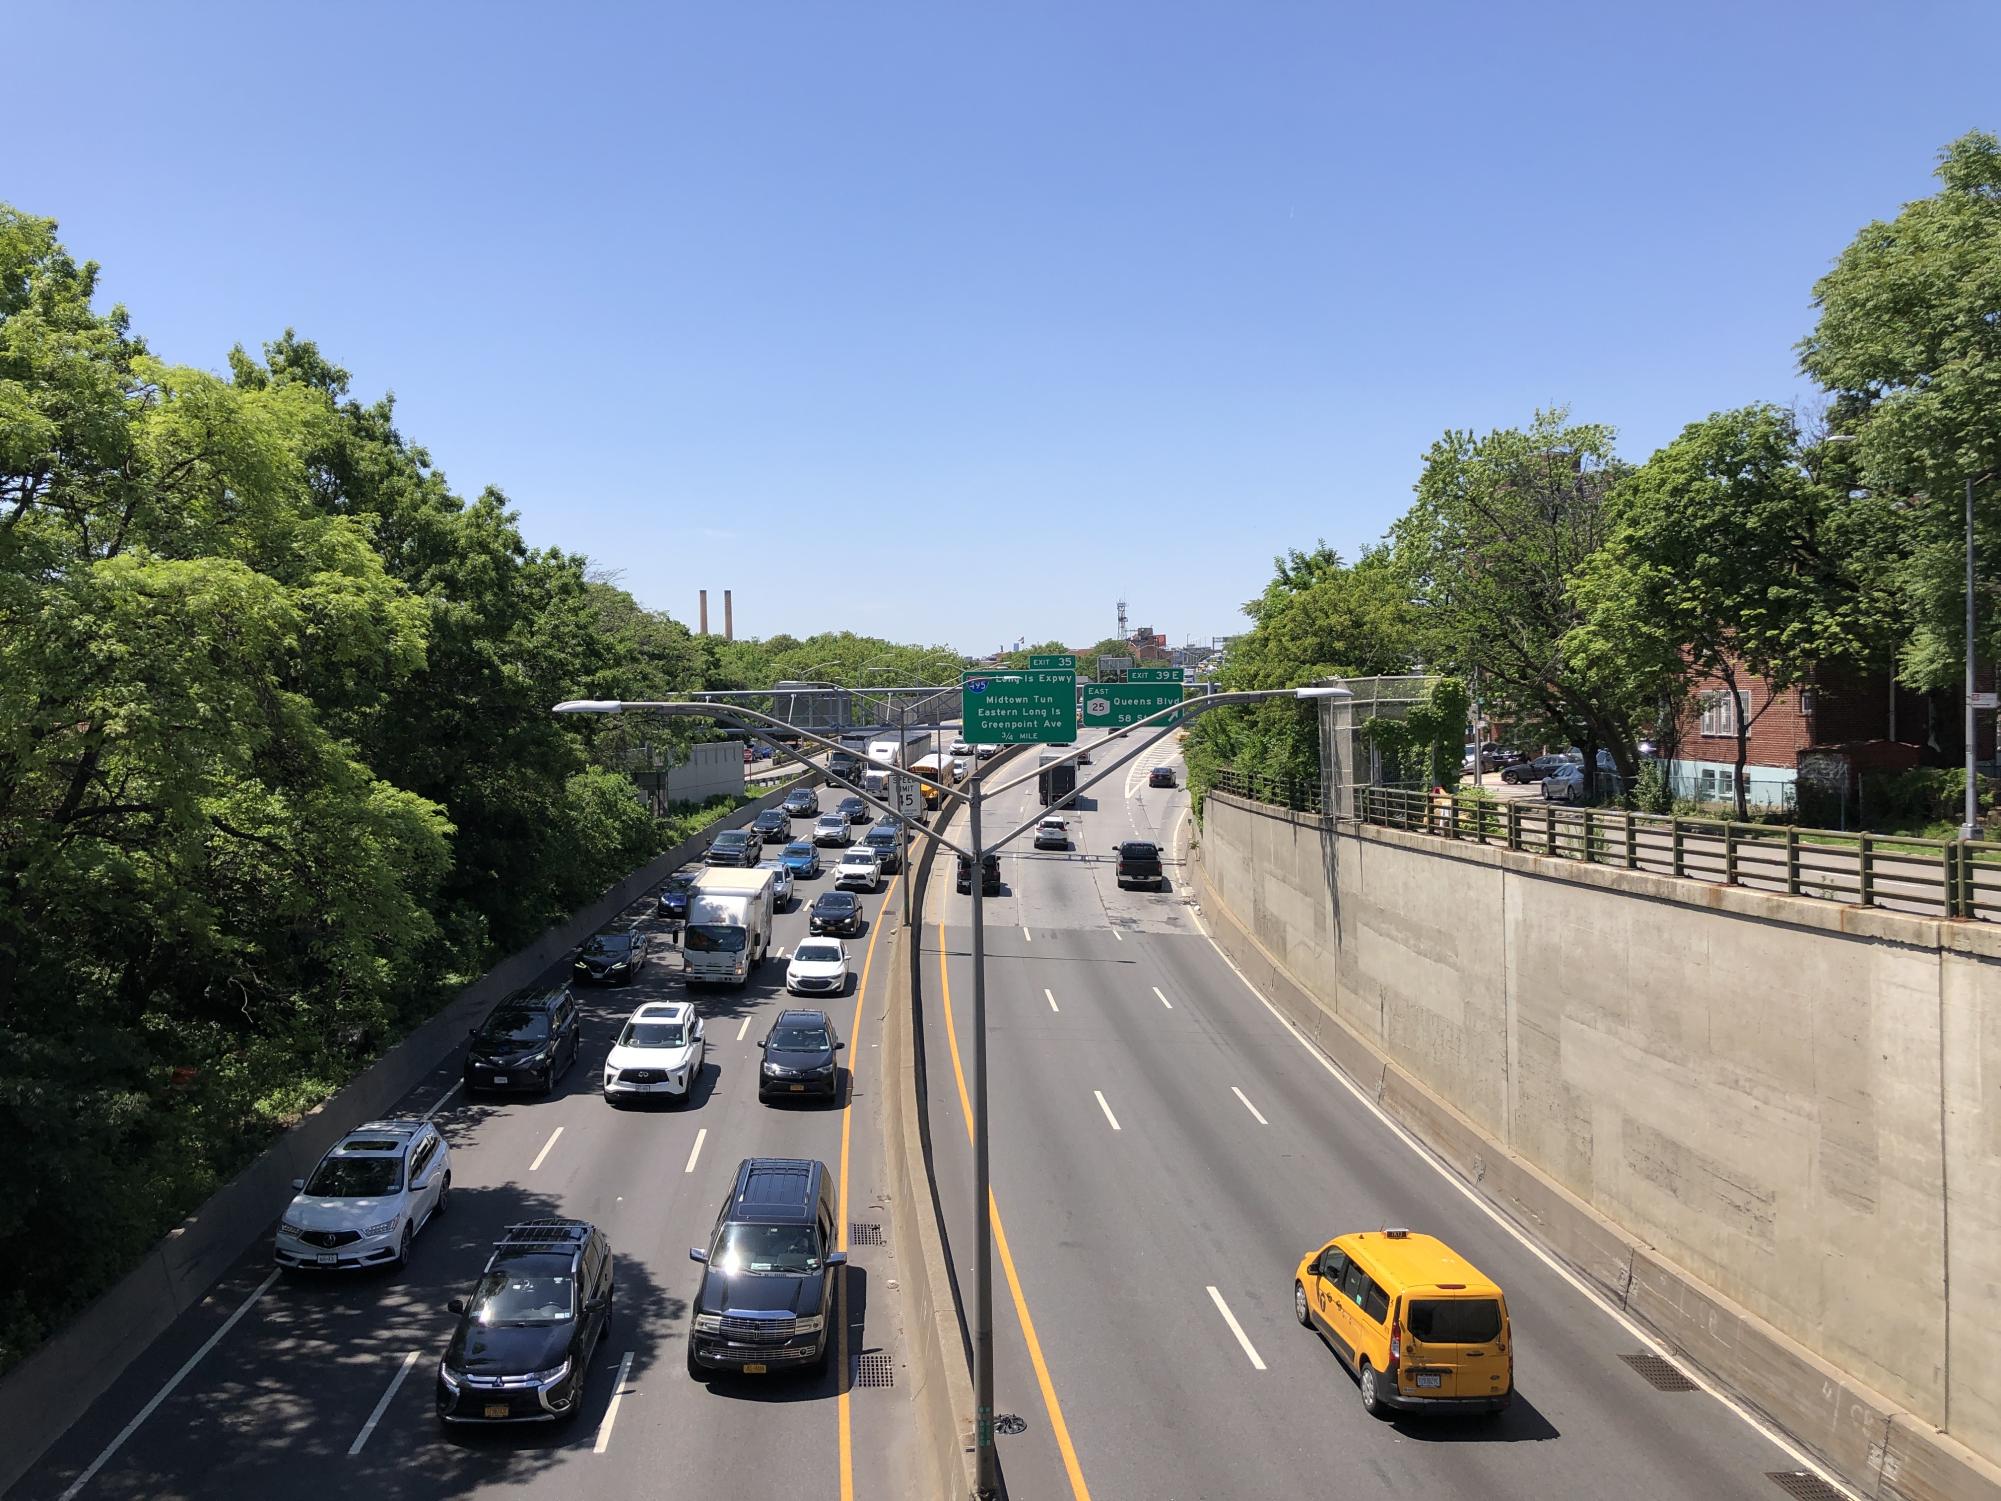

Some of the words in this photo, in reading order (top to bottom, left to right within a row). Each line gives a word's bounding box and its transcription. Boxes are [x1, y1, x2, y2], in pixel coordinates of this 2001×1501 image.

[1058, 657, 1072, 667] 35
[1039, 674, 1072, 684] Expwy
[1155, 671, 1170, 680] 39
[1172, 671, 1179, 680] E
[969, 680, 986, 690] 495
[1088, 687, 1109, 695] EAST
[986, 695, 1029, 704] Midtown
[1033, 695, 1053, 703] Tun
[1113, 697, 1152, 706] Queens
[1156, 697, 1180, 705] Blvd
[1092, 702, 1105, 711] 25
[978, 708, 1018, 717] Eastern
[1022, 708, 1047, 717] Long
[1051, 707, 1061, 715] Is
[1118, 714, 1132, 722] 58
[981, 720, 1038, 729] Greenpoint
[1043, 719, 1062, 728] Ave
[1019, 732, 1038, 740] MILE
[898, 785, 914, 793] IMIT
